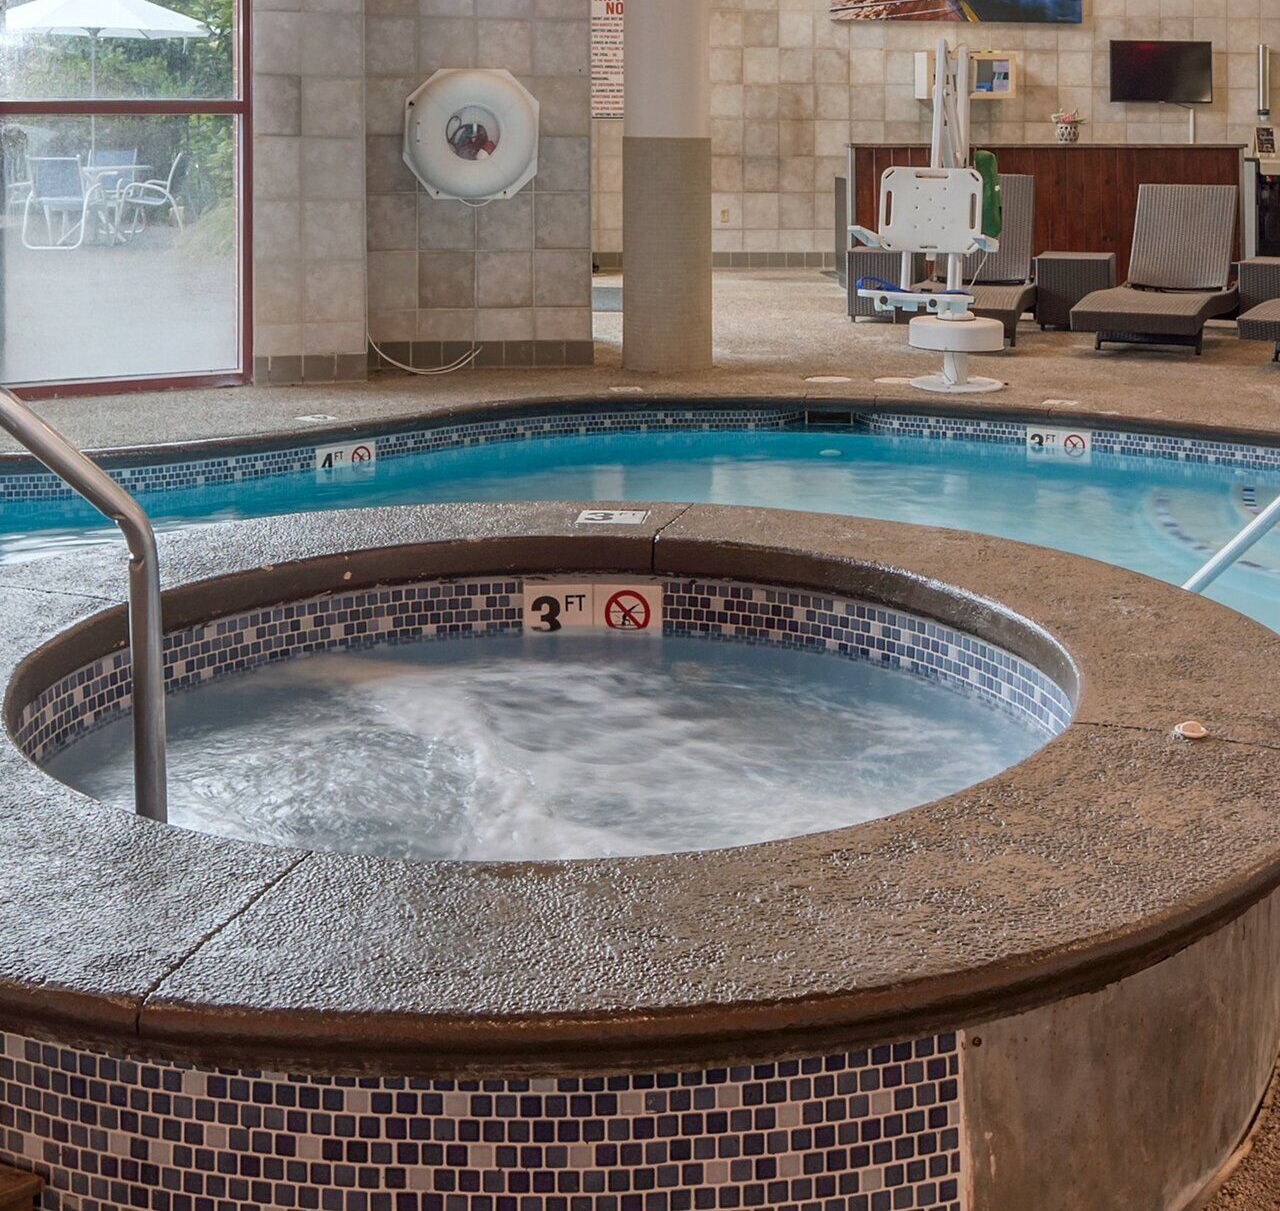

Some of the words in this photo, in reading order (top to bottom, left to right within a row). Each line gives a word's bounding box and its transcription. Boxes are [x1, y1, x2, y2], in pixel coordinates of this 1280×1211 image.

[1045, 434, 1056, 443] FT
[334, 450, 344, 461] FT
[584, 512, 614, 521] 3
[531, 595, 562, 633] 3
[565, 594, 586, 613] FT
